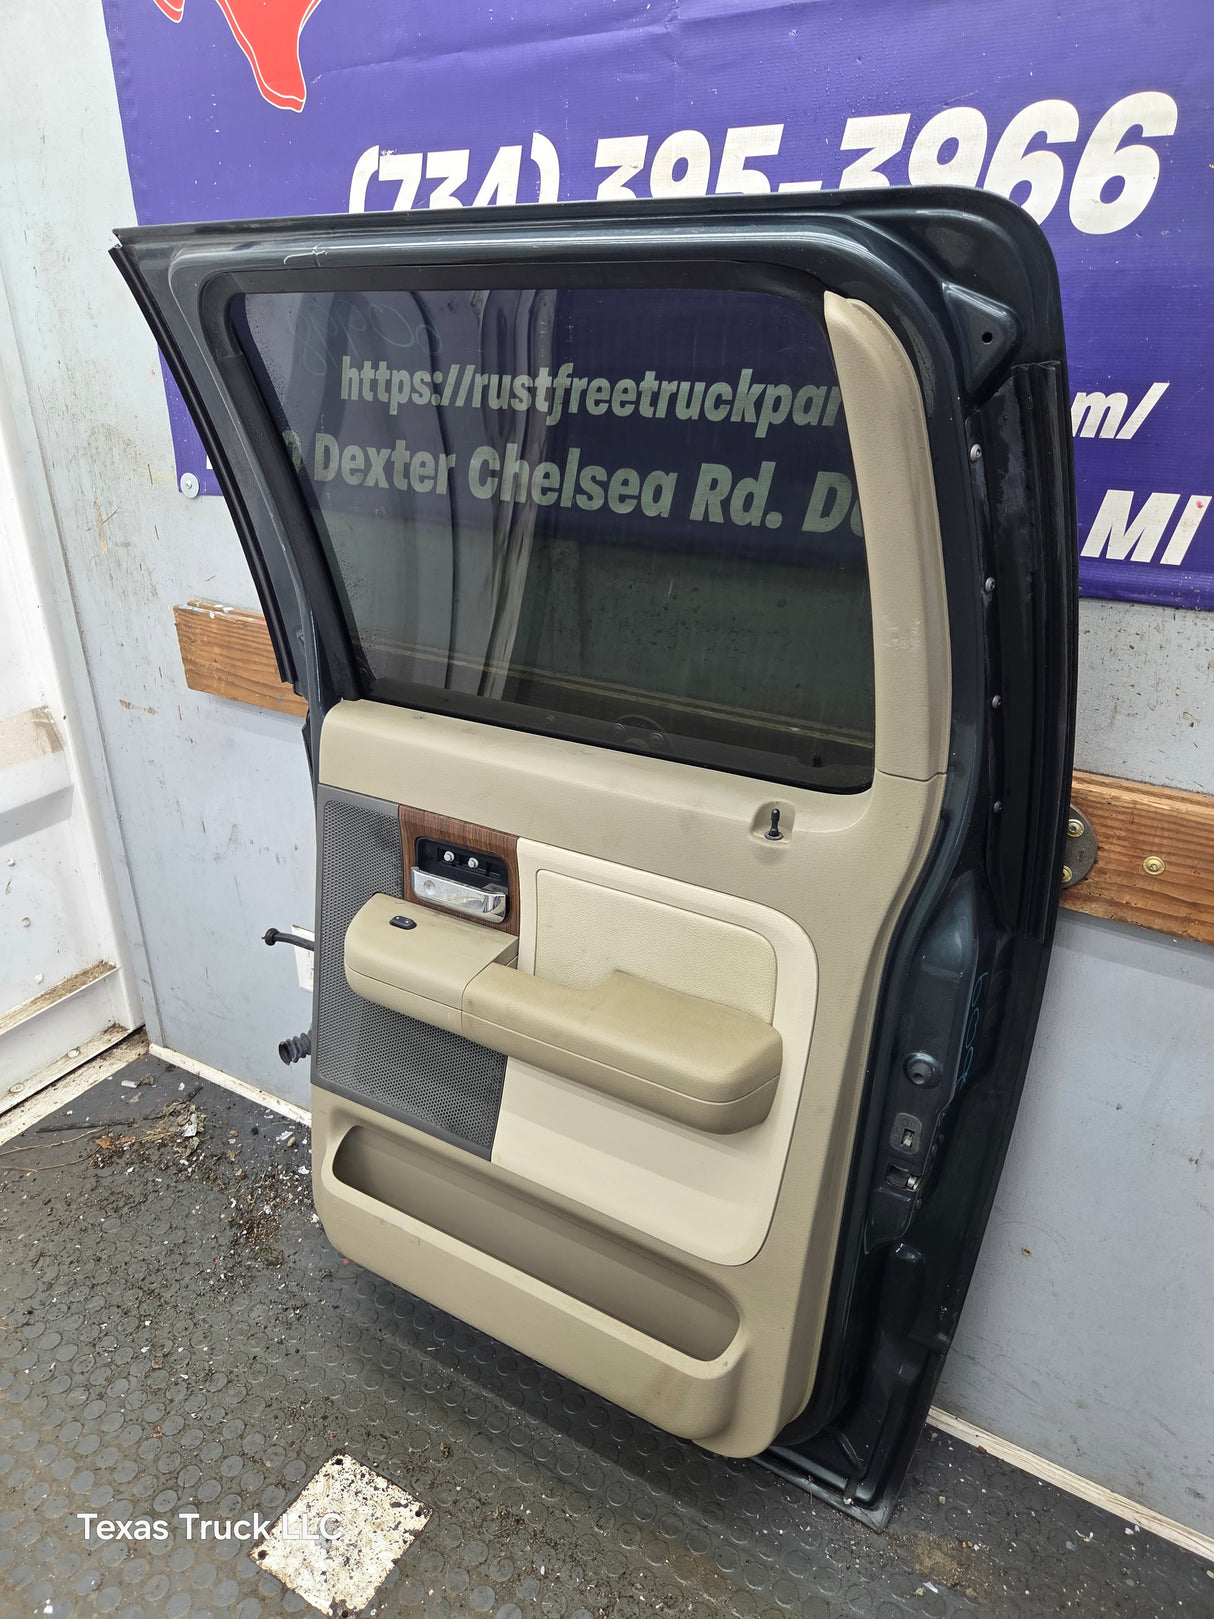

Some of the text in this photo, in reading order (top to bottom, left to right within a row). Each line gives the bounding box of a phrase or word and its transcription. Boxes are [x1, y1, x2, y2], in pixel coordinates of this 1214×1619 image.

[313, 432, 456, 495] Dexter
[469, 447, 678, 518] Chelsea
[688, 461, 783, 529] Rd.
[1080, 489, 1213, 566] MI
